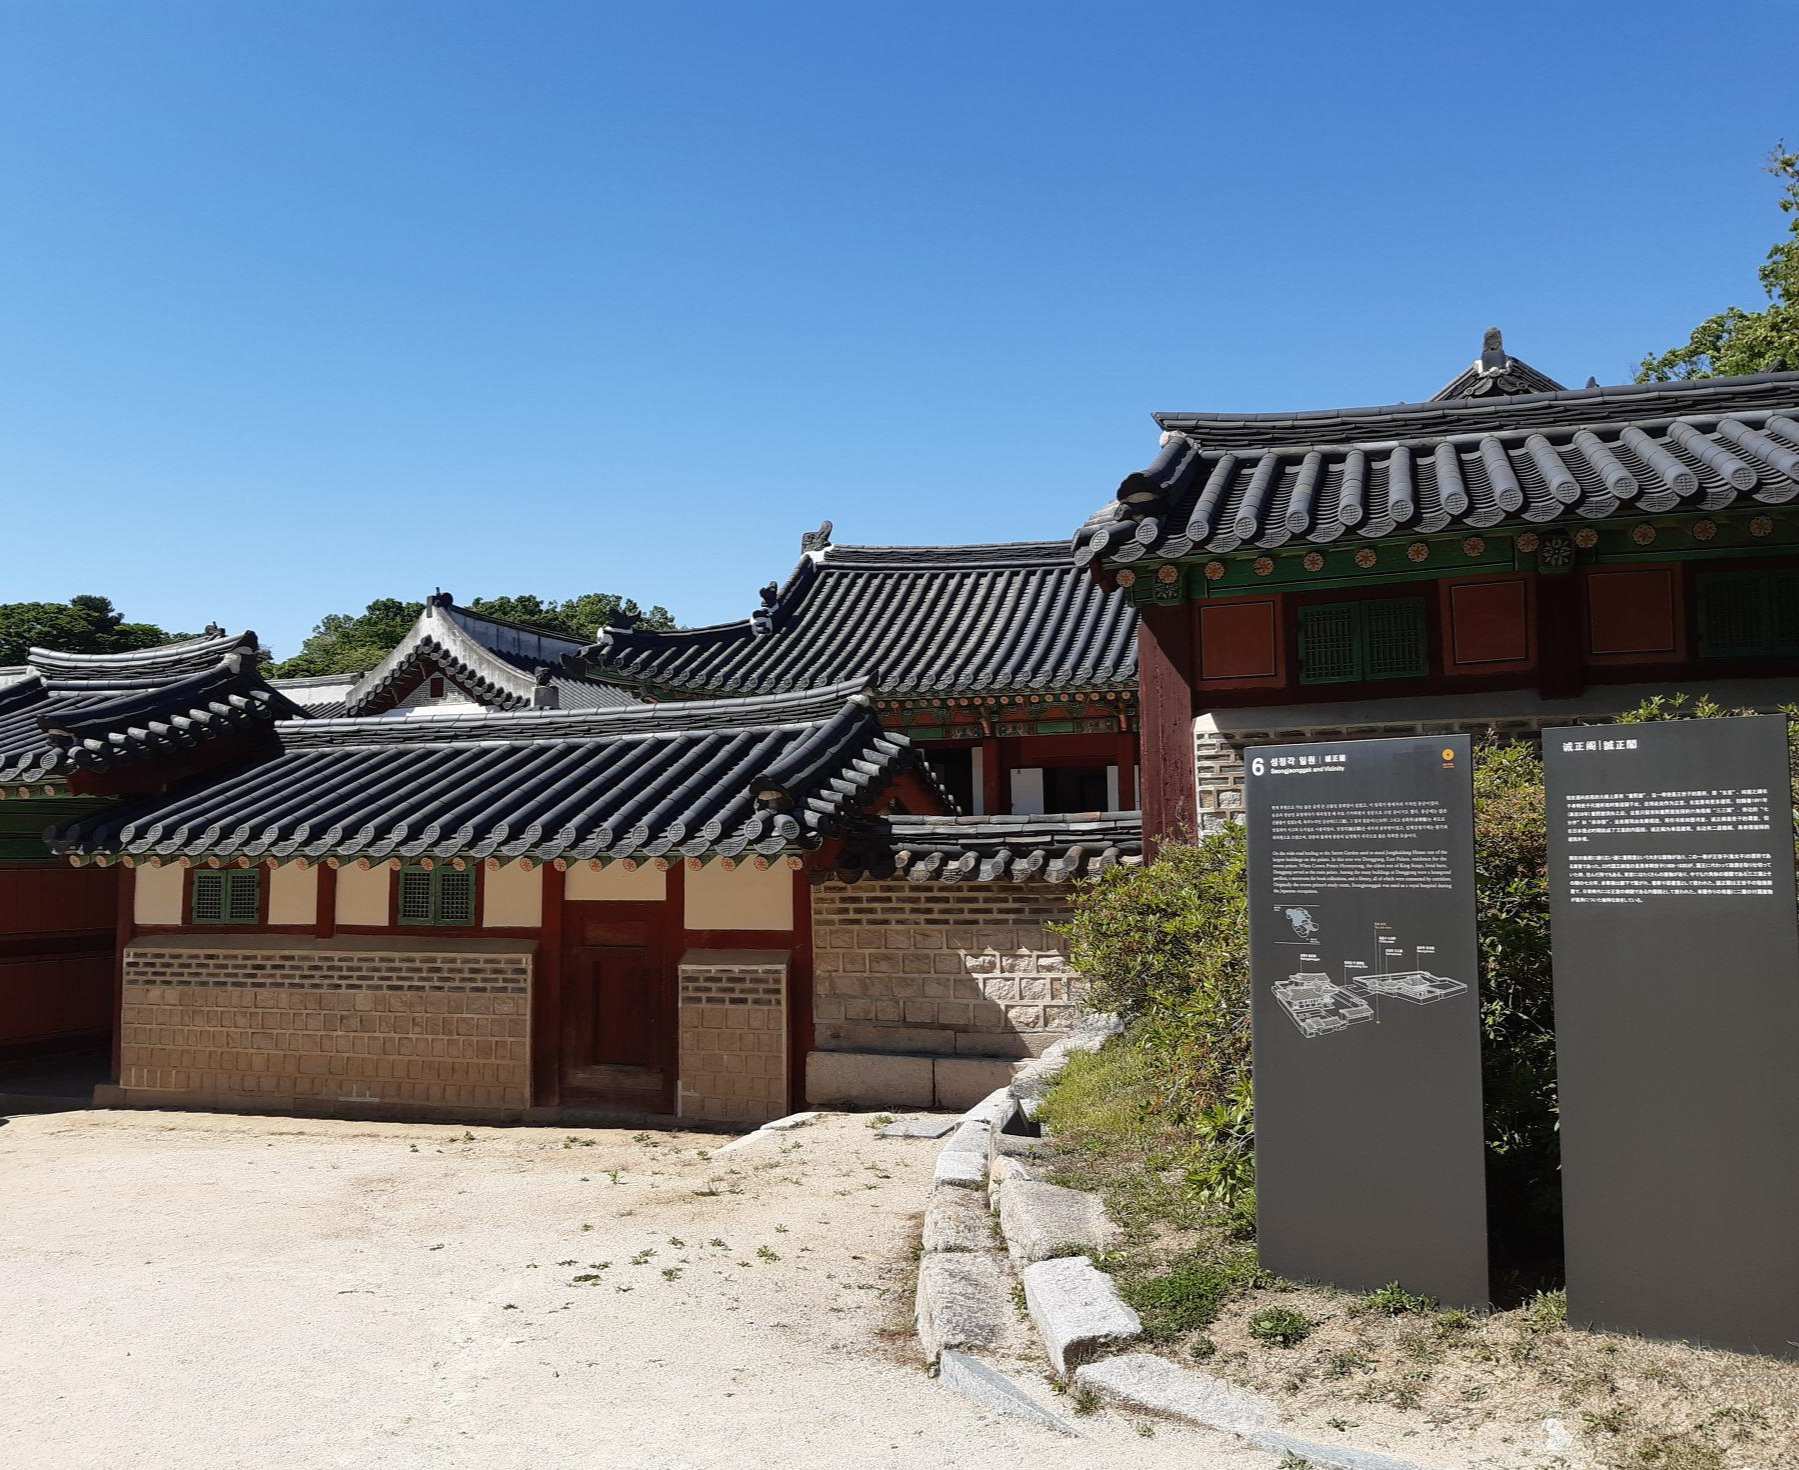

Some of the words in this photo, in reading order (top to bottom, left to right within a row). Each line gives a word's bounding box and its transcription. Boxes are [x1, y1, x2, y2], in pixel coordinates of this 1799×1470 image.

[1251, 757, 1264, 776] 6
[1270, 756, 1295, 767] 성정각
[1298, 755, 1316, 765] 일원
